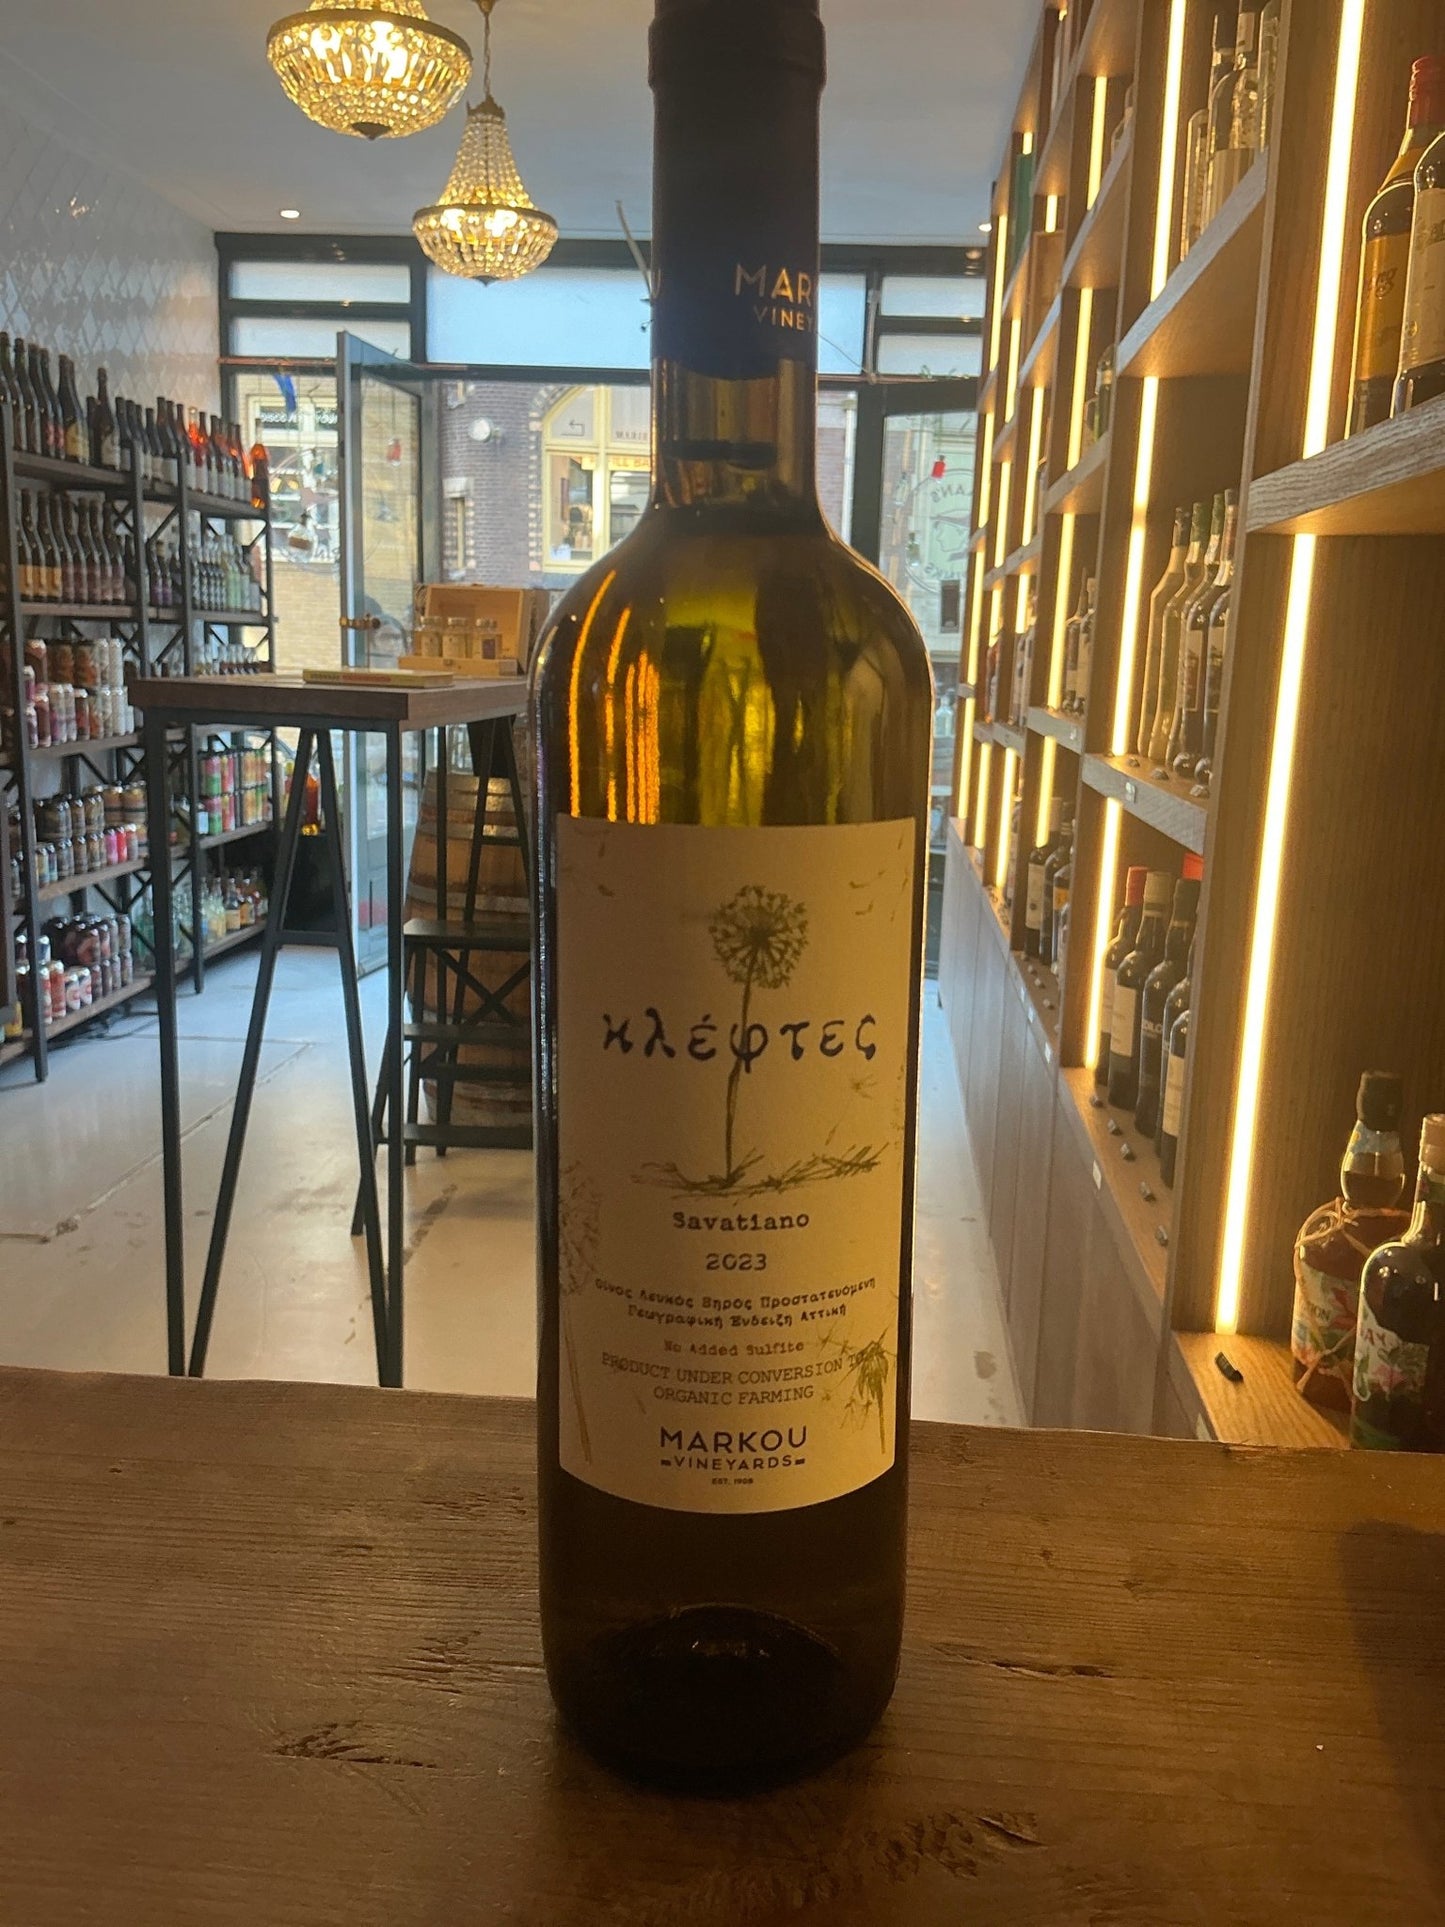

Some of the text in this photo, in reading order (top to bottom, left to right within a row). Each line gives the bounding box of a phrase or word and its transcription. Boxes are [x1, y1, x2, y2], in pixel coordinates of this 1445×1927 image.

[603, 1007, 877, 1073] κλέφτες
[672, 1211, 810, 1232] Savatiano
[705, 1253, 767, 1271] 2023
[689, 1343, 739, 1357] Added
[601, 1351, 671, 1380] PRODUCT
[677, 1368, 734, 1385] UNDER
[738, 1358, 843, 1385] CONVERSION
[653, 1385, 814, 1405] ORGANIC FARMING
[660, 1425, 807, 1454] MARKOU
[673, 1454, 793, 1471] VINEYARDS
